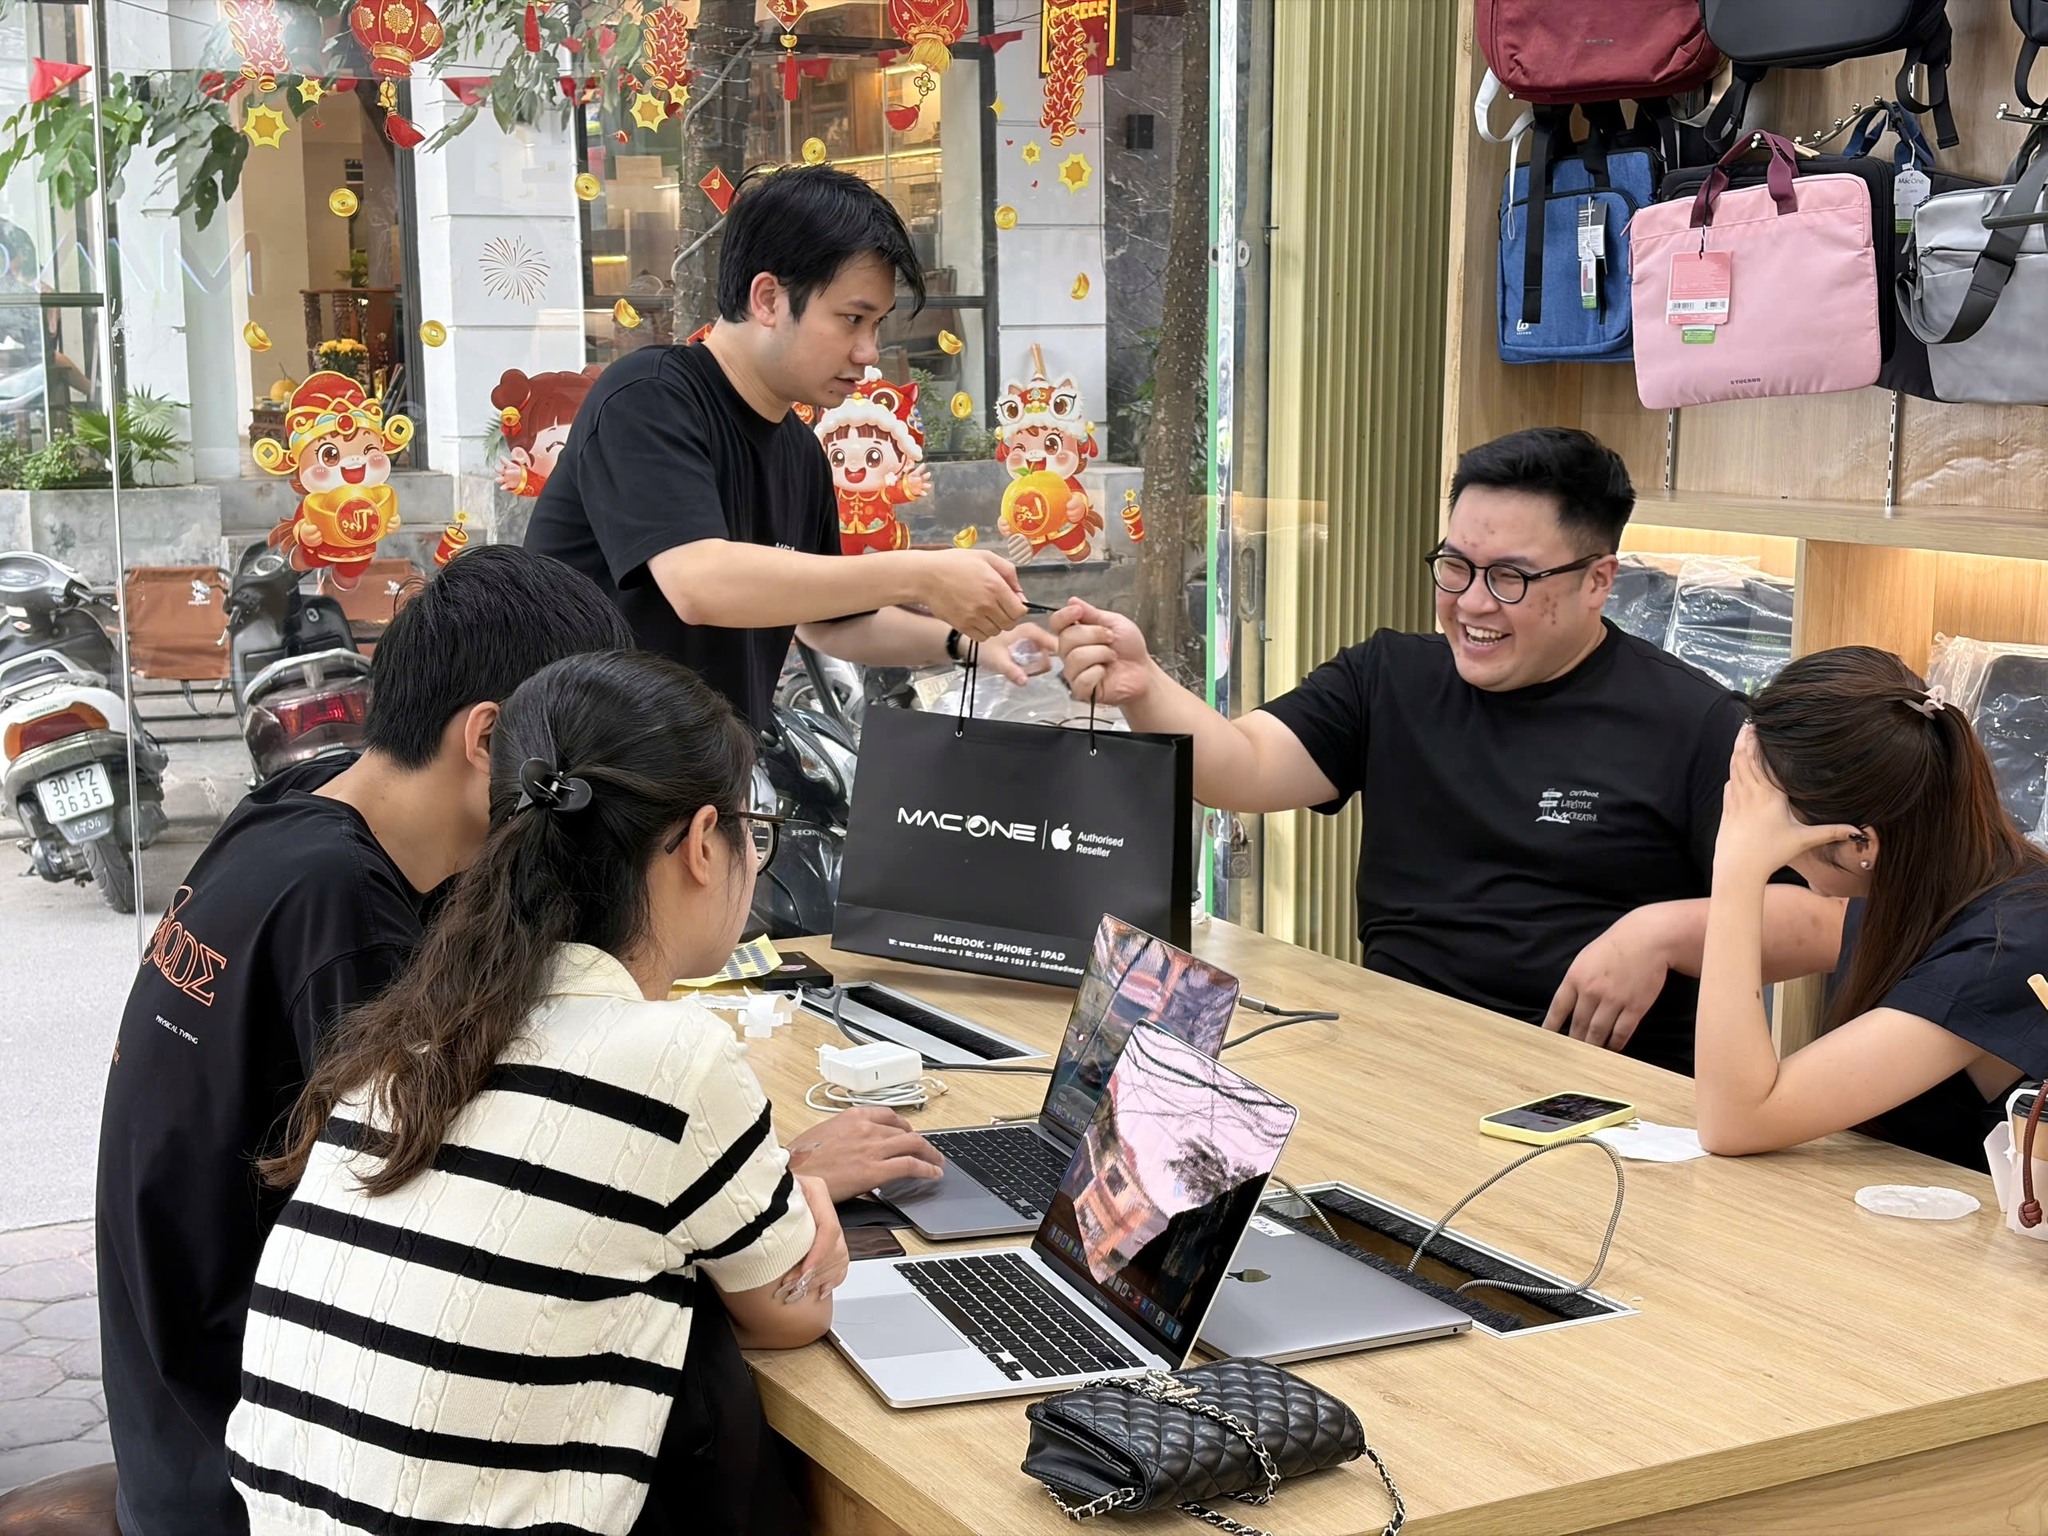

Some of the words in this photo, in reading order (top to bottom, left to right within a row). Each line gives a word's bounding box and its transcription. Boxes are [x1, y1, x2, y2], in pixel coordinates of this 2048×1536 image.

[55, 787, 103, 818] 3635
[1076, 843, 1111, 858] Reseller
[1077, 831, 1124, 848] Authorised
[933, 933, 985, 950] MACBOOK
[993, 942, 1032, 956] IPHONE
[1041, 949, 1066, 961] IPAD
